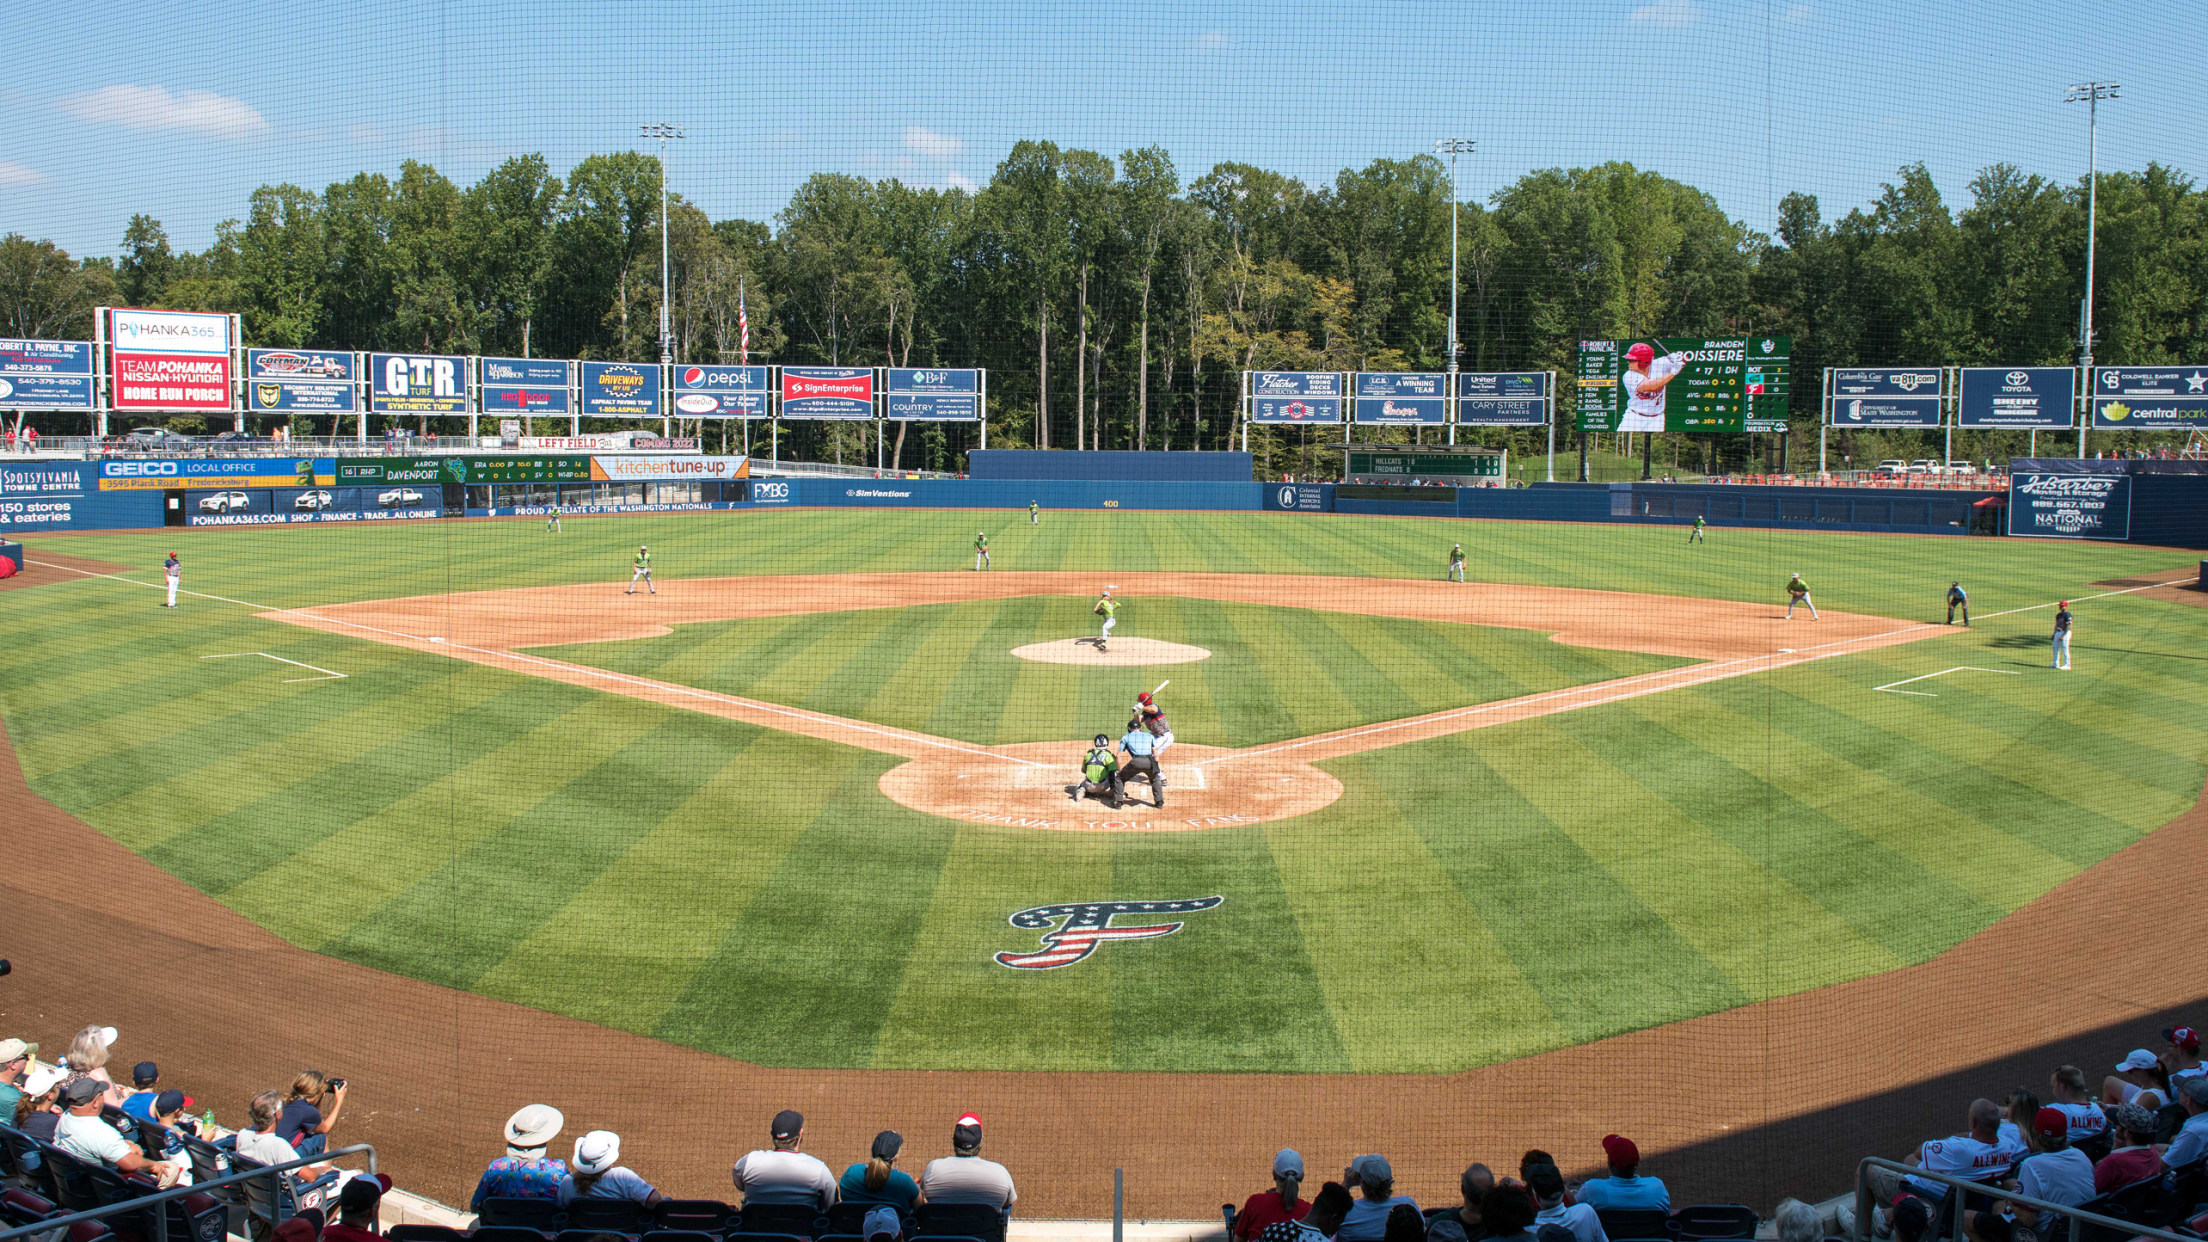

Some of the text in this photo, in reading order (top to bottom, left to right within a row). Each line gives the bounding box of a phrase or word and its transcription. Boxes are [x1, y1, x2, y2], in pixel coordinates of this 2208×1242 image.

[25, 343, 80, 353] B. PAYNE, INC.
[1704, 340, 1744, 348] BRANDEN
[1676, 350, 1745, 361] BOISSIERE
[120, 360, 223, 374] TEAM POHANKA
[386, 357, 455, 396] GTR
[599, 375, 644, 385] DRIVEWAYS
[1259, 374, 1298, 388] Fletcher
[1838, 372, 1867, 380] Columbia
[124, 387, 224, 401] HOME RUN PORCH
[410, 388, 431, 396] TURF
[804, 384, 864, 394] SignEnterprise
[2133, 408, 2207, 420] central park
[538, 438, 565, 448] LEFT
[568, 438, 596, 448] FIELD
[635, 439, 694, 448] COMING 2022
[104, 462, 256, 475] GEICO LOCAL OFFICE
[4, 470, 80, 484] SPOTSYLVANIA
[387, 470, 439, 480] DAVENPORT
[107, 480, 129, 488] 3595
[188, 479, 249, 487] Fredericksburg
[754, 483, 788, 498] FXBG
[27, 502, 71, 512] stores
[619, 504, 670, 512] WASHINGTON
[0, 512, 71, 523] & eateries
[193, 513, 286, 525] POHANKA365.COM
[291, 510, 437, 523] SHOP FINANCE ONLINE
[2035, 514, 2102, 524] NATIONAL
[962, 809, 1260, 830] THANK YOU FANS
[2071, 1116, 2102, 1129] ALLWINE
[1972, 1152, 2011, 1168] ALLWINE
